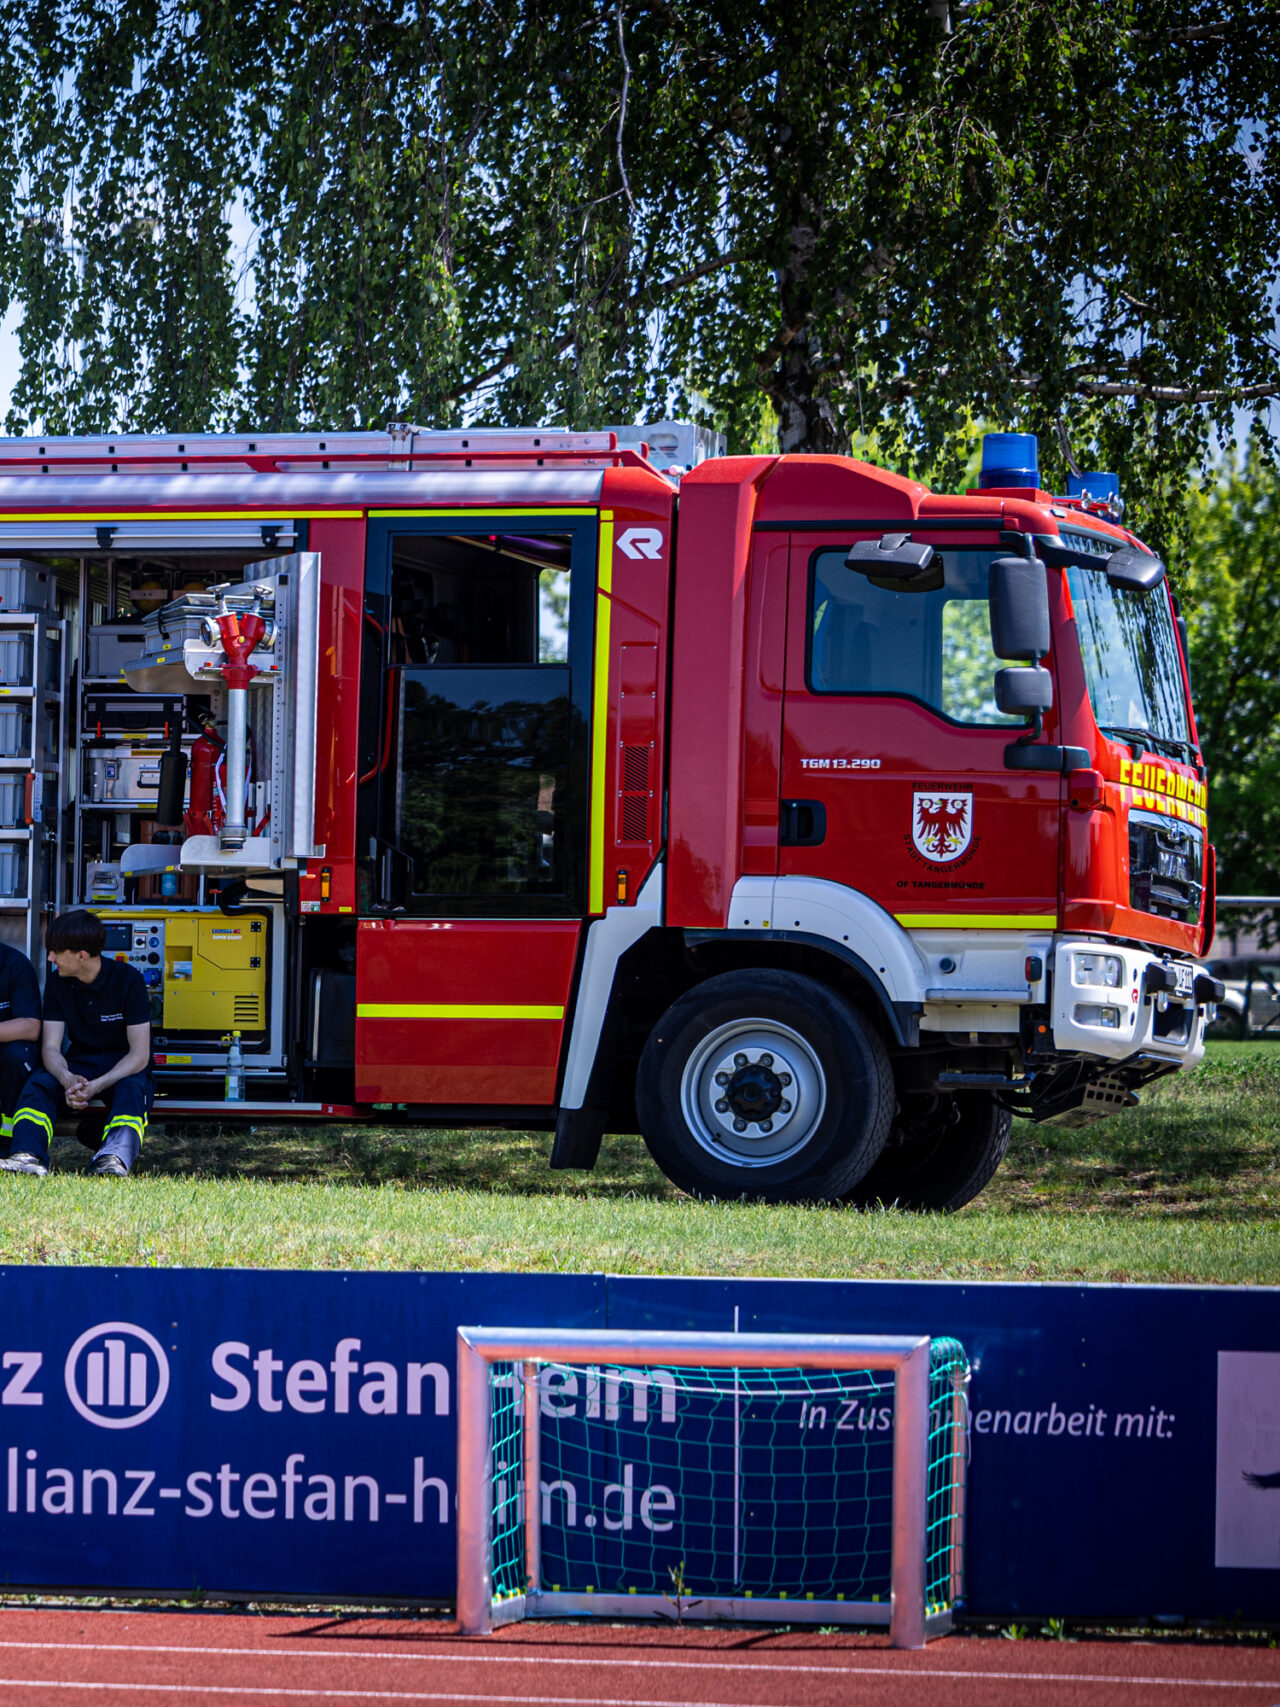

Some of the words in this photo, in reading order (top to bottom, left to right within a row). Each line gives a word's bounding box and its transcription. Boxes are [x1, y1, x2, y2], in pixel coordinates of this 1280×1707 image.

[800, 758, 832, 769] TGM
[832, 758, 881, 769] 13.290
[912, 782, 973, 791] FEUERWEHR
[1120, 758, 1207, 829] FEUERWEHR
[904, 833, 921, 863] STADT
[922, 835, 982, 874] TANGERMÜNDE
[896, 880, 909, 888] OF
[912, 880, 985, 890] TANGERMÜNDE
[209, 1338, 450, 1416] Stefan
[798, 1401, 826, 1429] In
[836, 1400, 1107, 1437] Zusenarbeit
[1114, 1406, 1176, 1438] mit:
